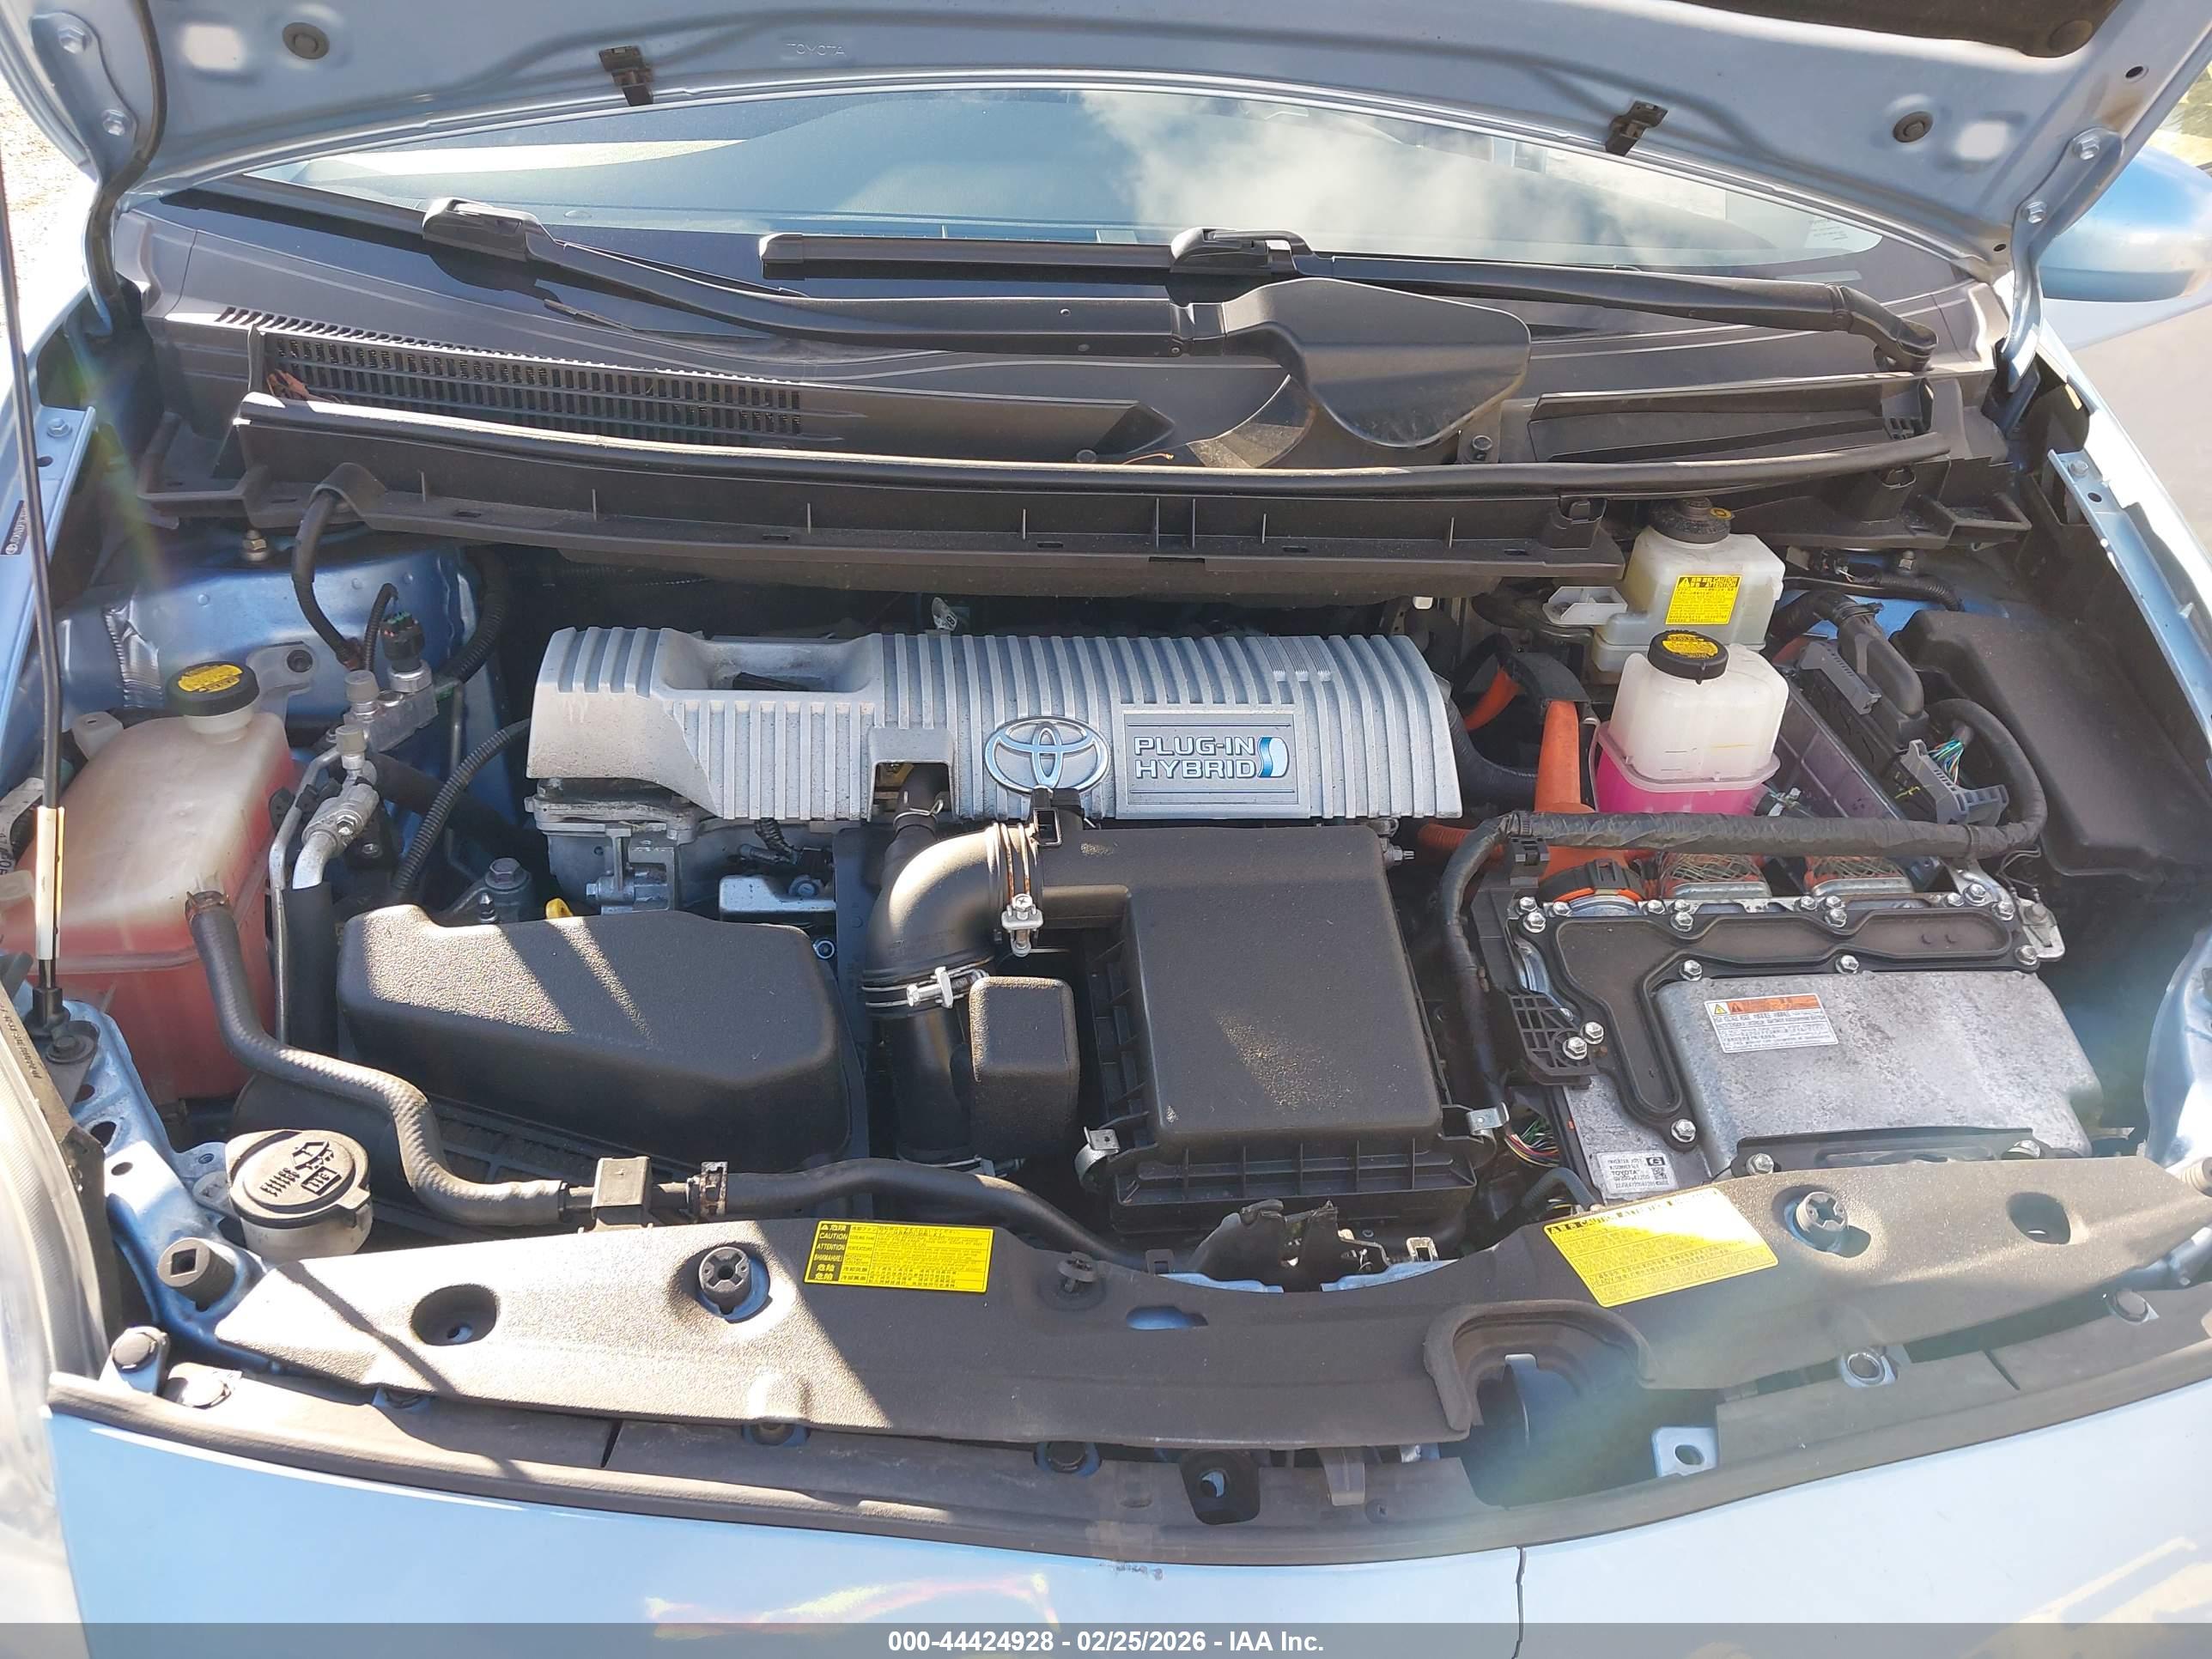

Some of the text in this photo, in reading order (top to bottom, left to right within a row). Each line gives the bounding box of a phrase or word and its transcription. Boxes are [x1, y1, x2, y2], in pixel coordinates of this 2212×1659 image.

[787, 44, 847, 57] TOYOTA
[1133, 737, 1255, 756] PLUG-IN
[1135, 759, 1256, 779] HYBRID
[819, 1232, 848, 1241] CAUTION
